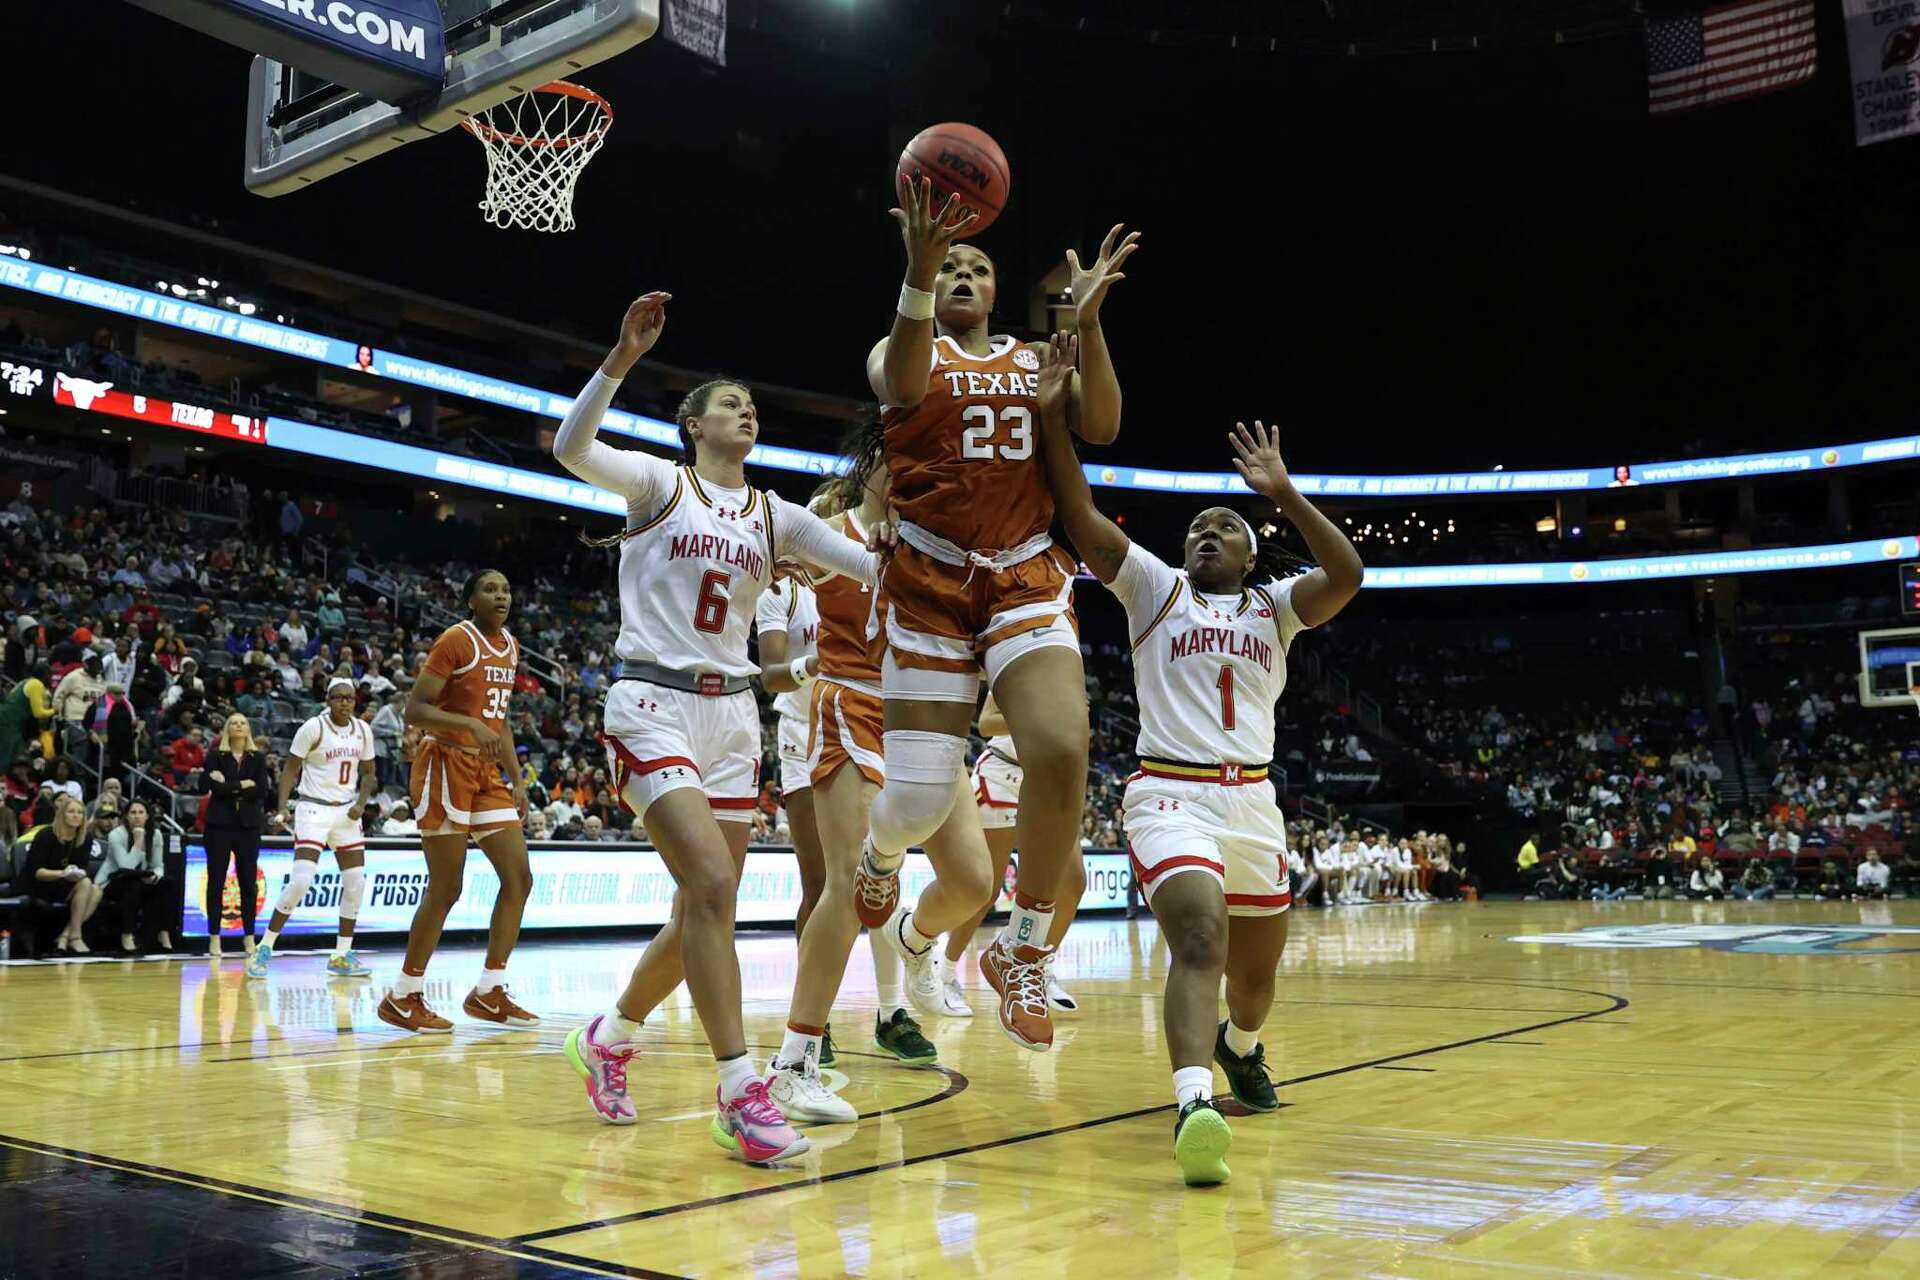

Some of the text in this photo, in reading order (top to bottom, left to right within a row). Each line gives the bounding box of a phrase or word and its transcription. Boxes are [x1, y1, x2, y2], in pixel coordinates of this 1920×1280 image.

[1872, 3, 1920, 26] DEVIL
[1862, 91, 1920, 118] CHAMP
[962, 405, 1034, 461] 23
[669, 533, 763, 583] MARYLAND
[693, 568, 732, 635] 6
[1169, 627, 1273, 675] MARYLAND
[484, 666, 516, 683] TEXA
[1216, 664, 1236, 731] 1
[339, 761, 352, 785] 0
[1226, 765, 1240, 782] M
